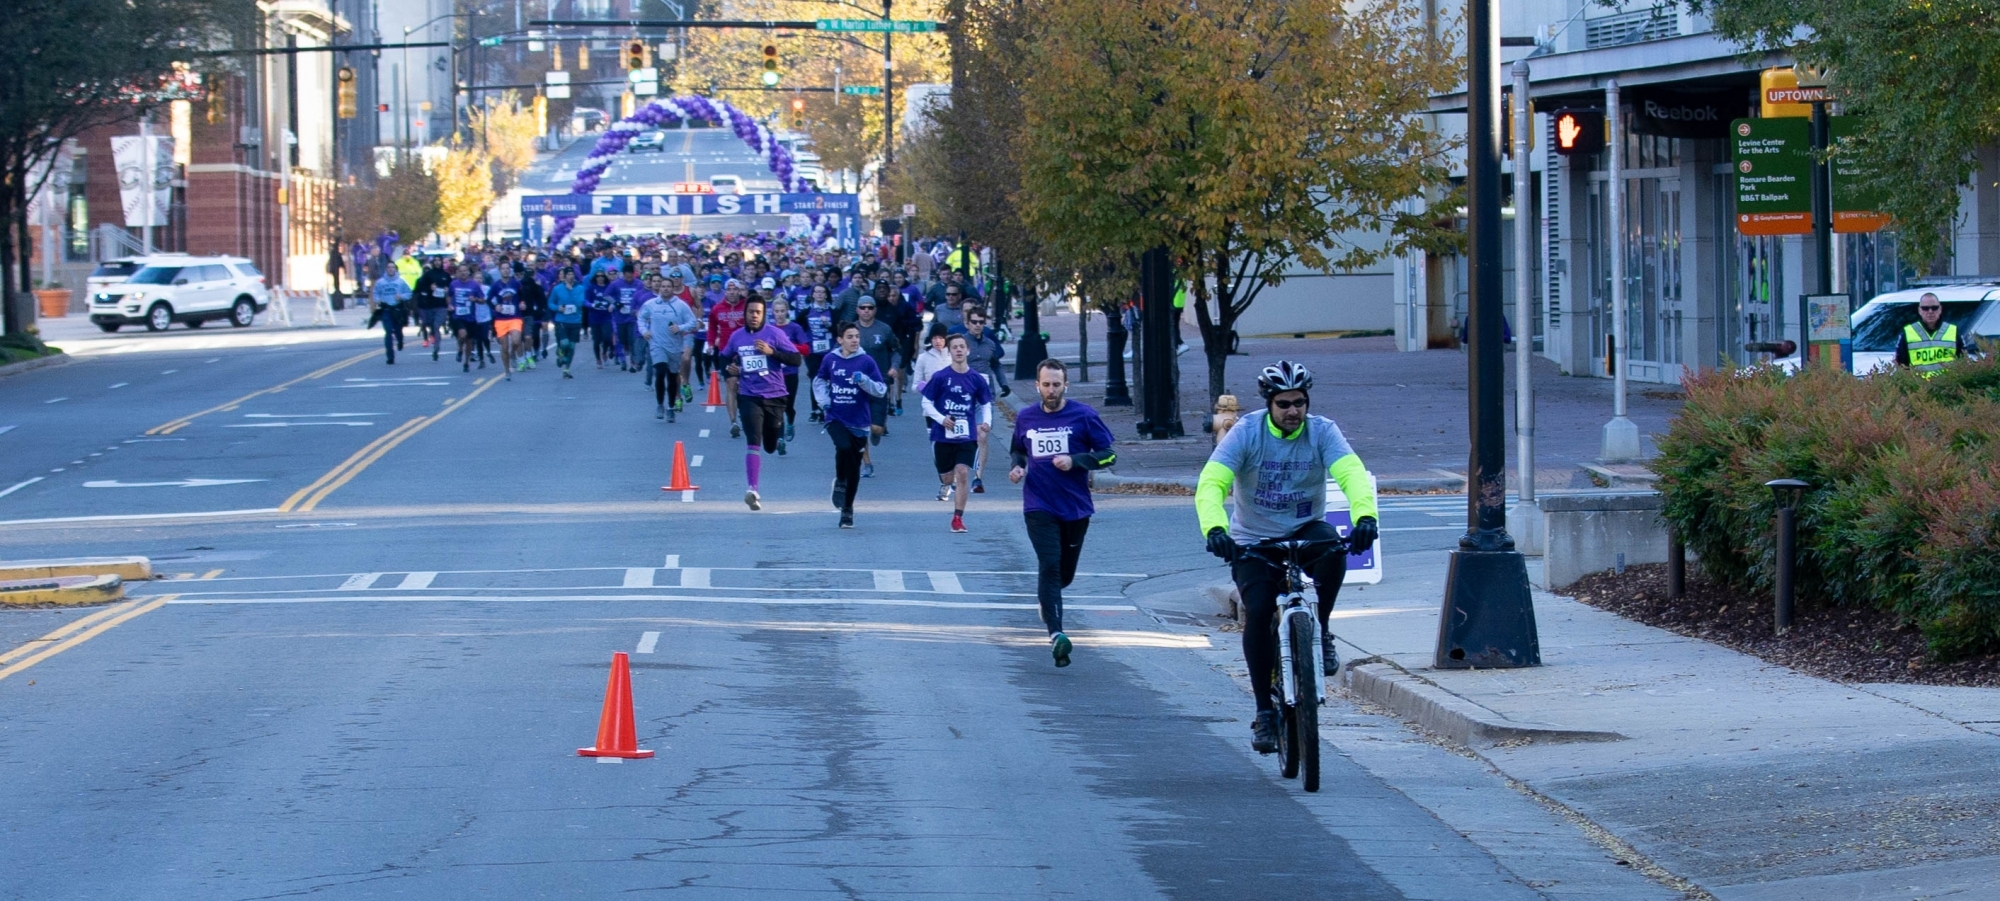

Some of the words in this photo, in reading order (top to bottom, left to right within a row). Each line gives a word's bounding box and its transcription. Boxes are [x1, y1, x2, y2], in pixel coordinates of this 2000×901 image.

[841, 19, 865, 29] Martin
[867, 20, 891, 30] Luther
[893, 21, 911, 32] King
[1769, 90, 1823, 102] UPTOWN
[1644, 100, 1719, 121] Reebok
[1738, 139, 1760, 147] Levine
[1762, 138, 1786, 146] Center
[1761, 193, 1789, 202] Ballpark
[592, 195, 780, 214] FINISH
[1916, 348, 1950, 361] POLICE
[746, 360, 763, 369] 500
[1038, 440, 1062, 453] 503
[1258, 471, 1273, 481] THE
[1268, 482, 1283, 492] END
[1254, 489, 1306, 502] PANCREATIC
